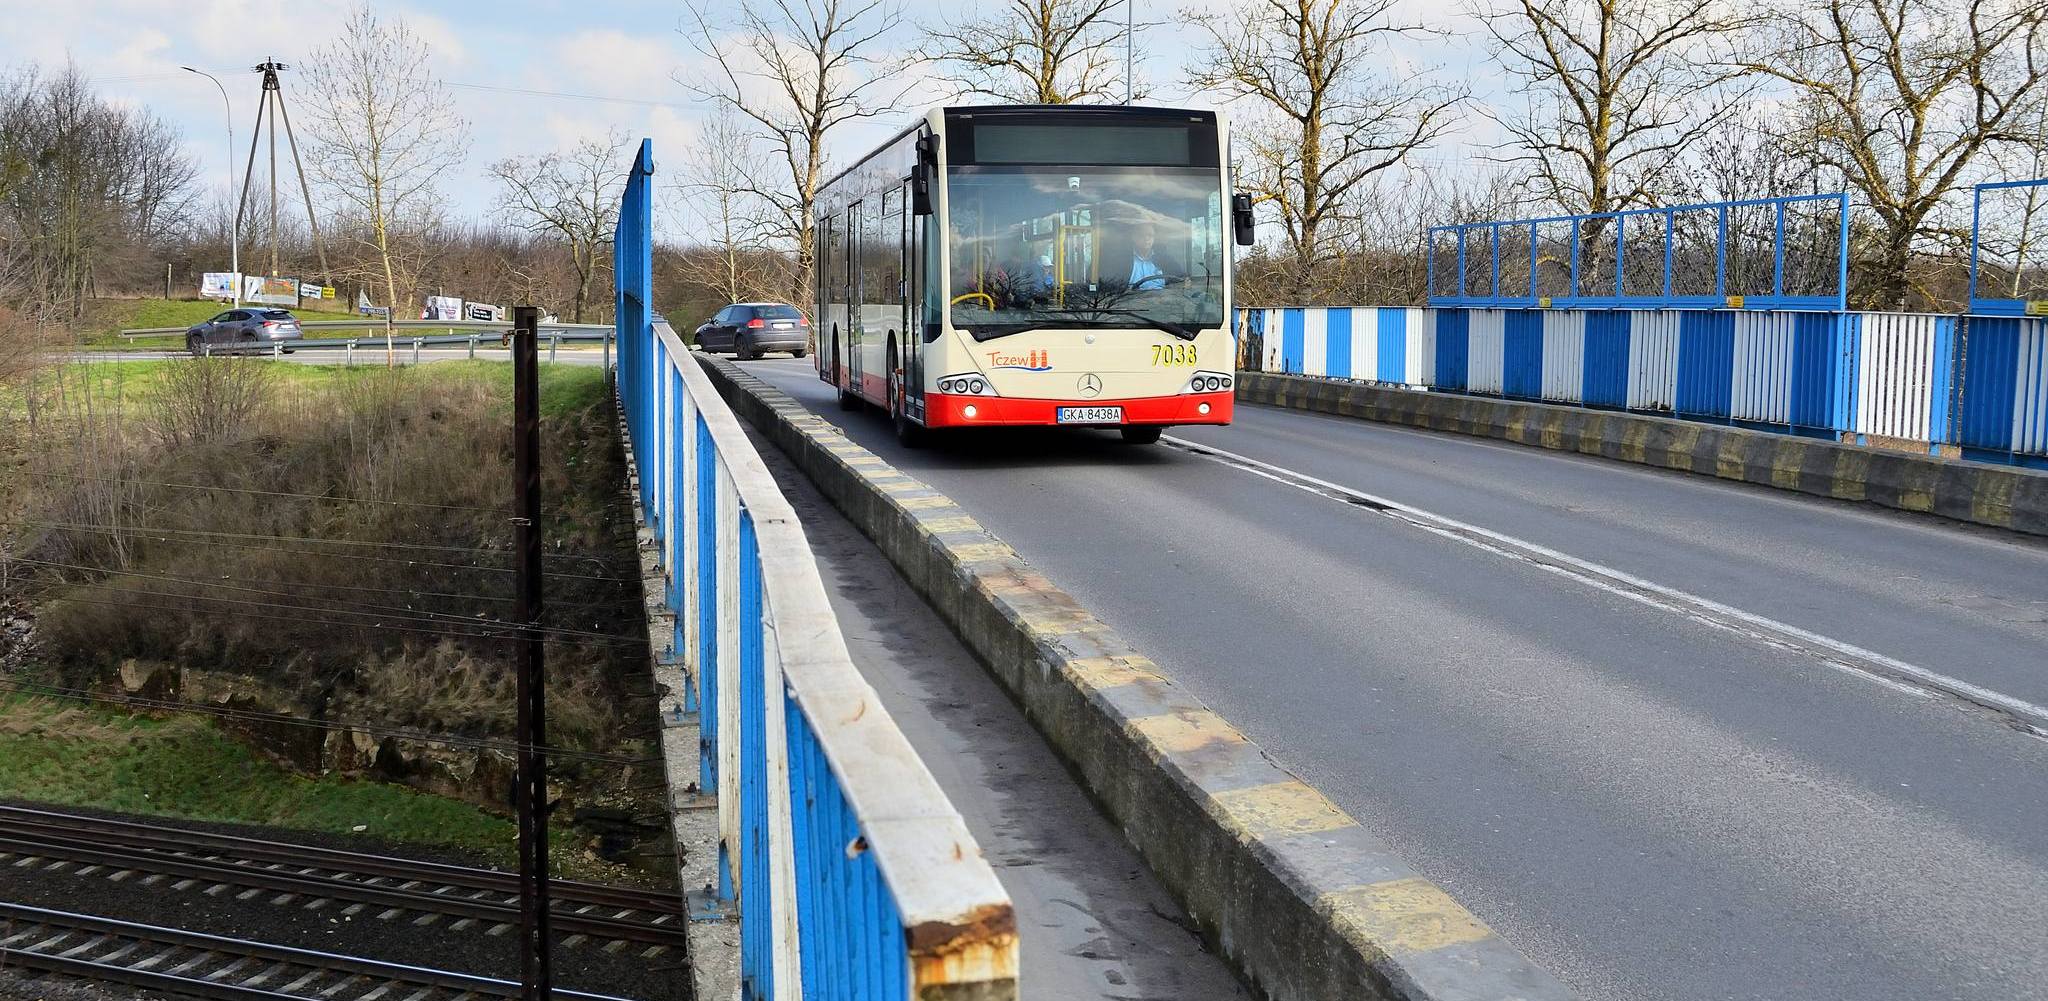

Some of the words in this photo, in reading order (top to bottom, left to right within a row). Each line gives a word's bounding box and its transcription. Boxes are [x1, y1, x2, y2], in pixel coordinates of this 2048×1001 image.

[986, 351, 1029, 367] Tczew
[1152, 344, 1197, 366] 7038
[1063, 408, 1084, 420] GKA
[1087, 408, 1120, 420] 8438A
